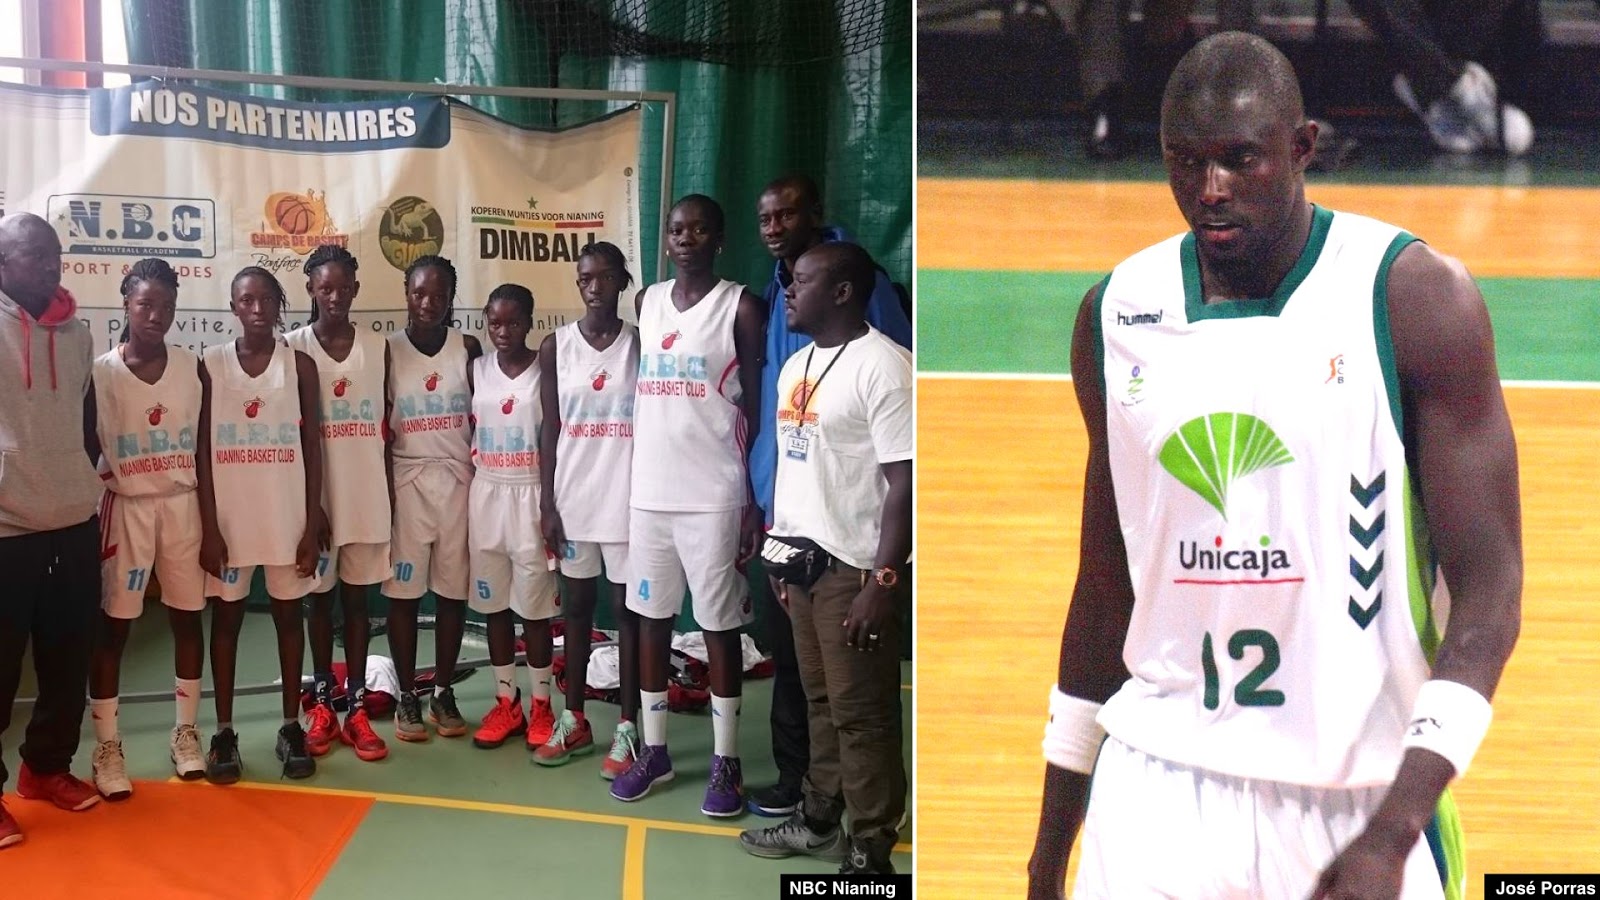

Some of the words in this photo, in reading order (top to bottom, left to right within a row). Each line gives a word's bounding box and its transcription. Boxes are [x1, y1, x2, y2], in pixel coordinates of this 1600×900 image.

[130, 89, 199, 127] NOS
[207, 96, 417, 142] PARTENAIRES
[471, 206, 506, 217] KOPEREN
[541, 212, 565, 221] VOOR
[567, 211, 605, 221] NIANING
[251, 233, 290, 247] CAMPS
[291, 234, 305, 247] DE
[92, 246, 140, 254] BASKETBALL
[62, 262, 111, 275] PORT
[251, 253, 302, 275] Boniface
[176, 317, 234, 335] vite,
[372, 319, 395, 332] on
[1117, 309, 1163, 326] hummel
[656, 380, 684, 397] BASKET
[685, 381, 706, 398] CLUB
[332, 423, 358, 438] BASKET
[427, 416, 452, 431] BASKET
[590, 422, 618, 438] BASKET
[619, 423, 633, 438] CLU
[216, 449, 246, 464] NIANING
[247, 449, 277, 463] BASKET
[505, 451, 534, 467] BASKET
[119, 458, 151, 478] NIANING
[152, 455, 176, 472] BASKET
[1179, 535, 1291, 578] Unicaja
[127, 568, 146, 591] 11
[395, 562, 414, 582] 10
[477, 579, 491, 600] 5
[638, 579, 650, 601] 4
[1201, 629, 1286, 711] 12
